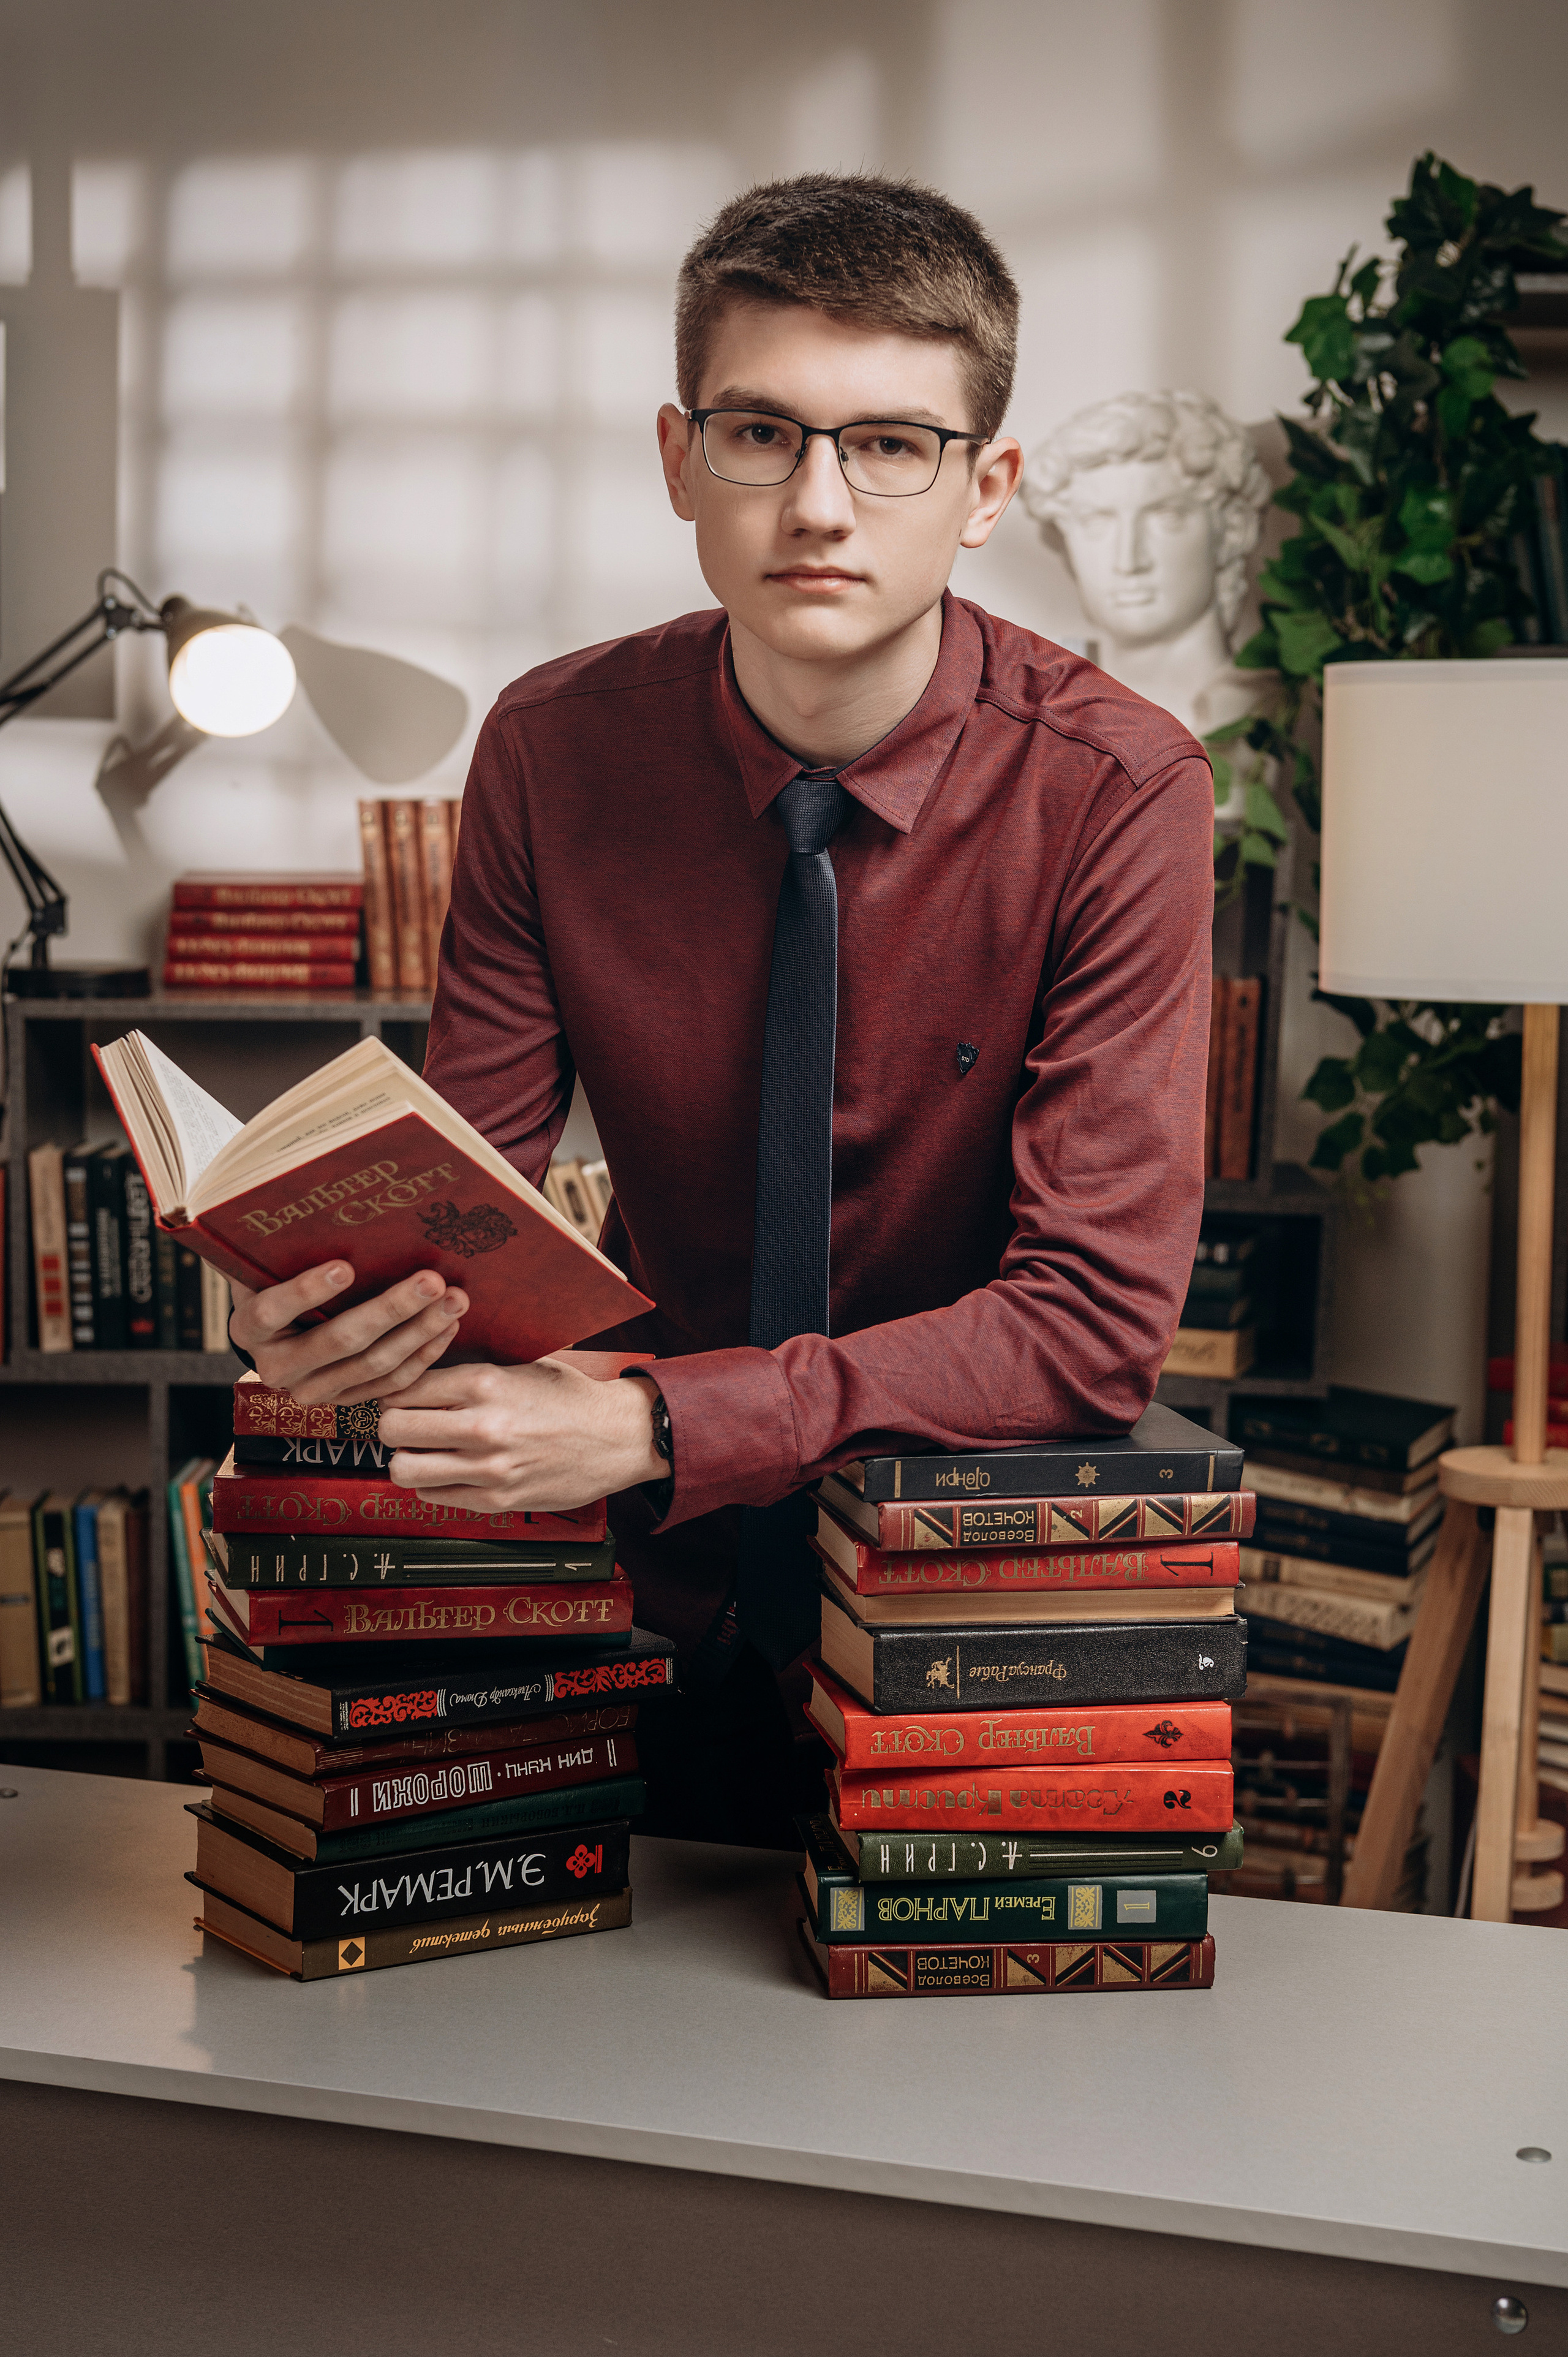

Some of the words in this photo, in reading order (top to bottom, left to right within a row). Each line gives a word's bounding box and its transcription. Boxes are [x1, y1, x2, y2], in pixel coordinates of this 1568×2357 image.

[236, 1160, 408, 1238] ВАЛЬТЕР
[334, 1162, 461, 1226] СКОТТ
[282, 1438, 393, 1468] МАРК
[1159, 1469, 1174, 1478] 3
[238, 1491, 350, 1524] СКОТТ
[962, 1510, 1035, 1526] КОЧЕТОВ
[1070, 1508, 1083, 1519] 2
[963, 1530, 1034, 1543] Всеволод
[880, 1559, 992, 1586] СКОТТ
[999, 1551, 1149, 1583] ВАЛЬТЕР
[1160, 1551, 1213, 1576] 1
[279, 1609, 334, 1635] 1
[344, 1601, 496, 1634] ВАЛЬТЕР
[503, 1597, 613, 1627] СКОТТ
[872, 1725, 963, 1755] СКОТТ
[979, 1720, 1096, 1755] ВАЛЬТЕР
[505, 1757, 552, 1779] КУНЦ
[559, 1749, 592, 1768] ДИН
[372, 1761, 493, 1812] ШОРОХИ
[862, 1782, 1001, 1815] Кристи
[1164, 1790, 1191, 1809] 2
[1010, 1788, 1133, 1815] Агата
[497, 1903, 601, 1939] Зарубежный
[878, 1897, 989, 1921] ПАРНОВ
[995, 1896, 1056, 1920] ЕРЕМЕЙ
[409, 1919, 491, 1954] детектив
[917, 1956, 990, 1970] КОЧЕТОВ
[1027, 1953, 1039, 1963] 3
[918, 1974, 989, 1986] Всеволод
